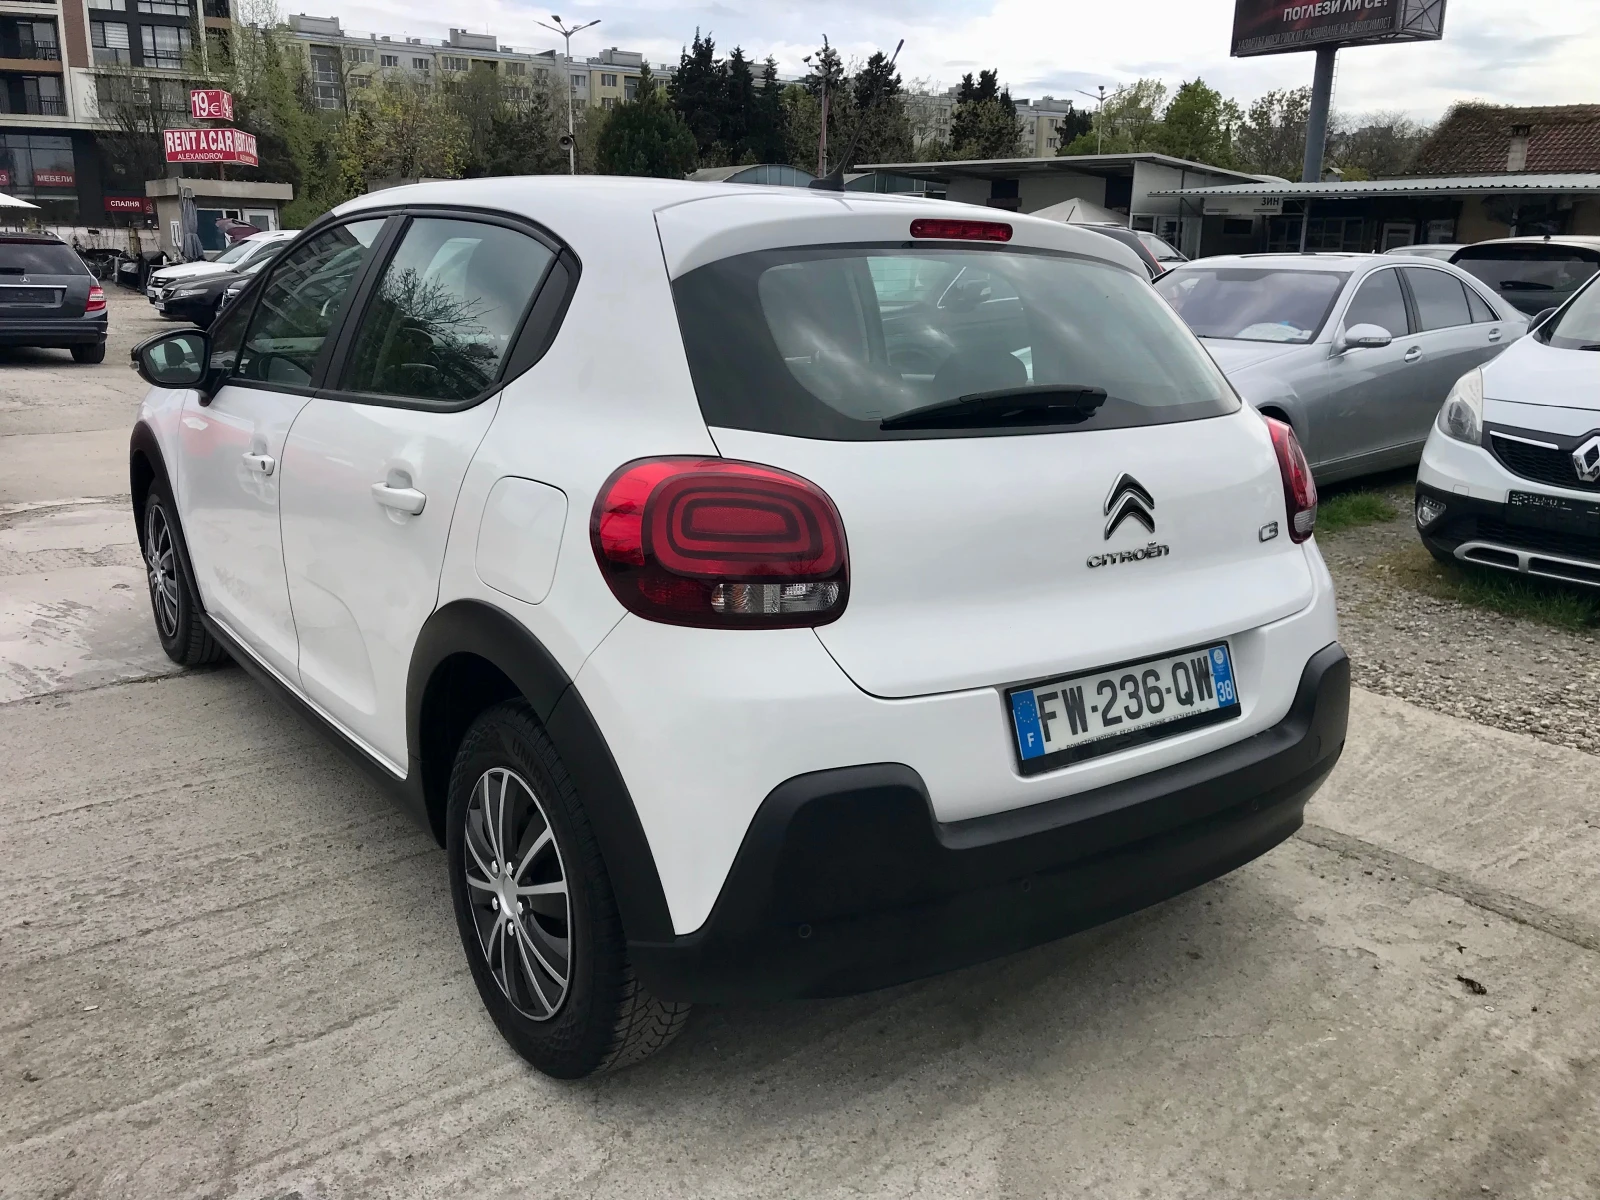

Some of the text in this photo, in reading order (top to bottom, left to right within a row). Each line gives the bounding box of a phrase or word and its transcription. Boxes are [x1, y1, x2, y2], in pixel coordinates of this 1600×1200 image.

[1283, 1, 1340, 21] ПОГЛЕЗИ
[1342, 0, 1362, 12] ЛИ
[165, 131, 234, 153] RENT A CAR
[177, 152, 224, 160] ALEXANDROV
[36, 174, 73, 183] МЕБЕЛИ
[110, 200, 140, 208] СПАЛНЯ
[1036, 655, 1214, 743] FW-236-QW
[1217, 679, 1233, 702] 38
[1026, 732, 1036, 748] F
